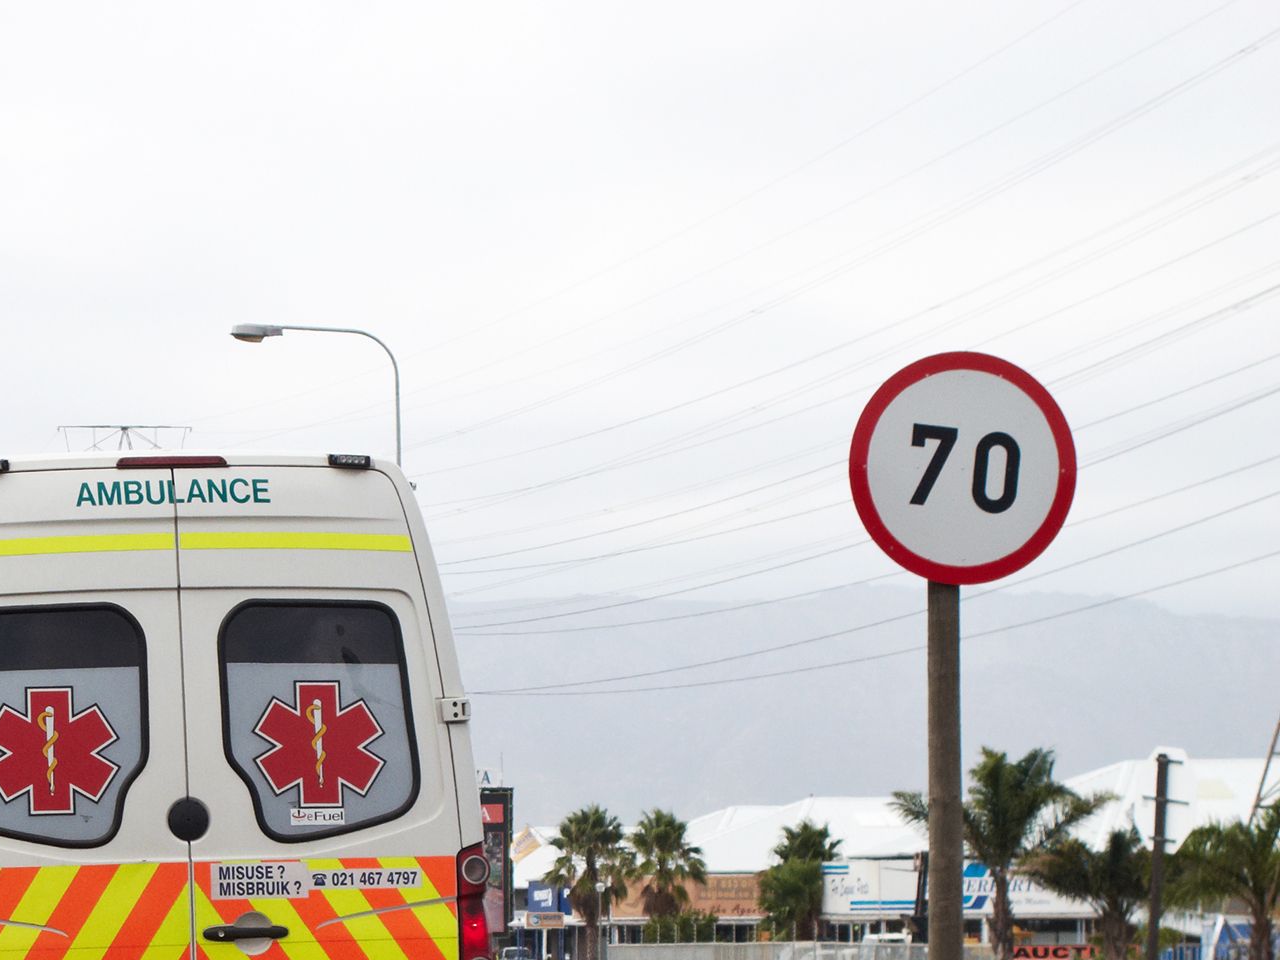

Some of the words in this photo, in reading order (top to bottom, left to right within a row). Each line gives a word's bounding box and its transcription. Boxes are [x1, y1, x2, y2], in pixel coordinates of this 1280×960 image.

[909, 423, 1021, 514] 70
[76, 478, 271, 507] AMBULANCE
[219, 866, 273, 880] MISUSE
[277, 865, 286, 879] ?
[331, 873, 355, 886] 021
[359, 872, 383, 886] 467
[387, 871, 418, 885] 4797
[219, 882, 290, 896] MISBRUIK
[293, 881, 302, 895] ?
